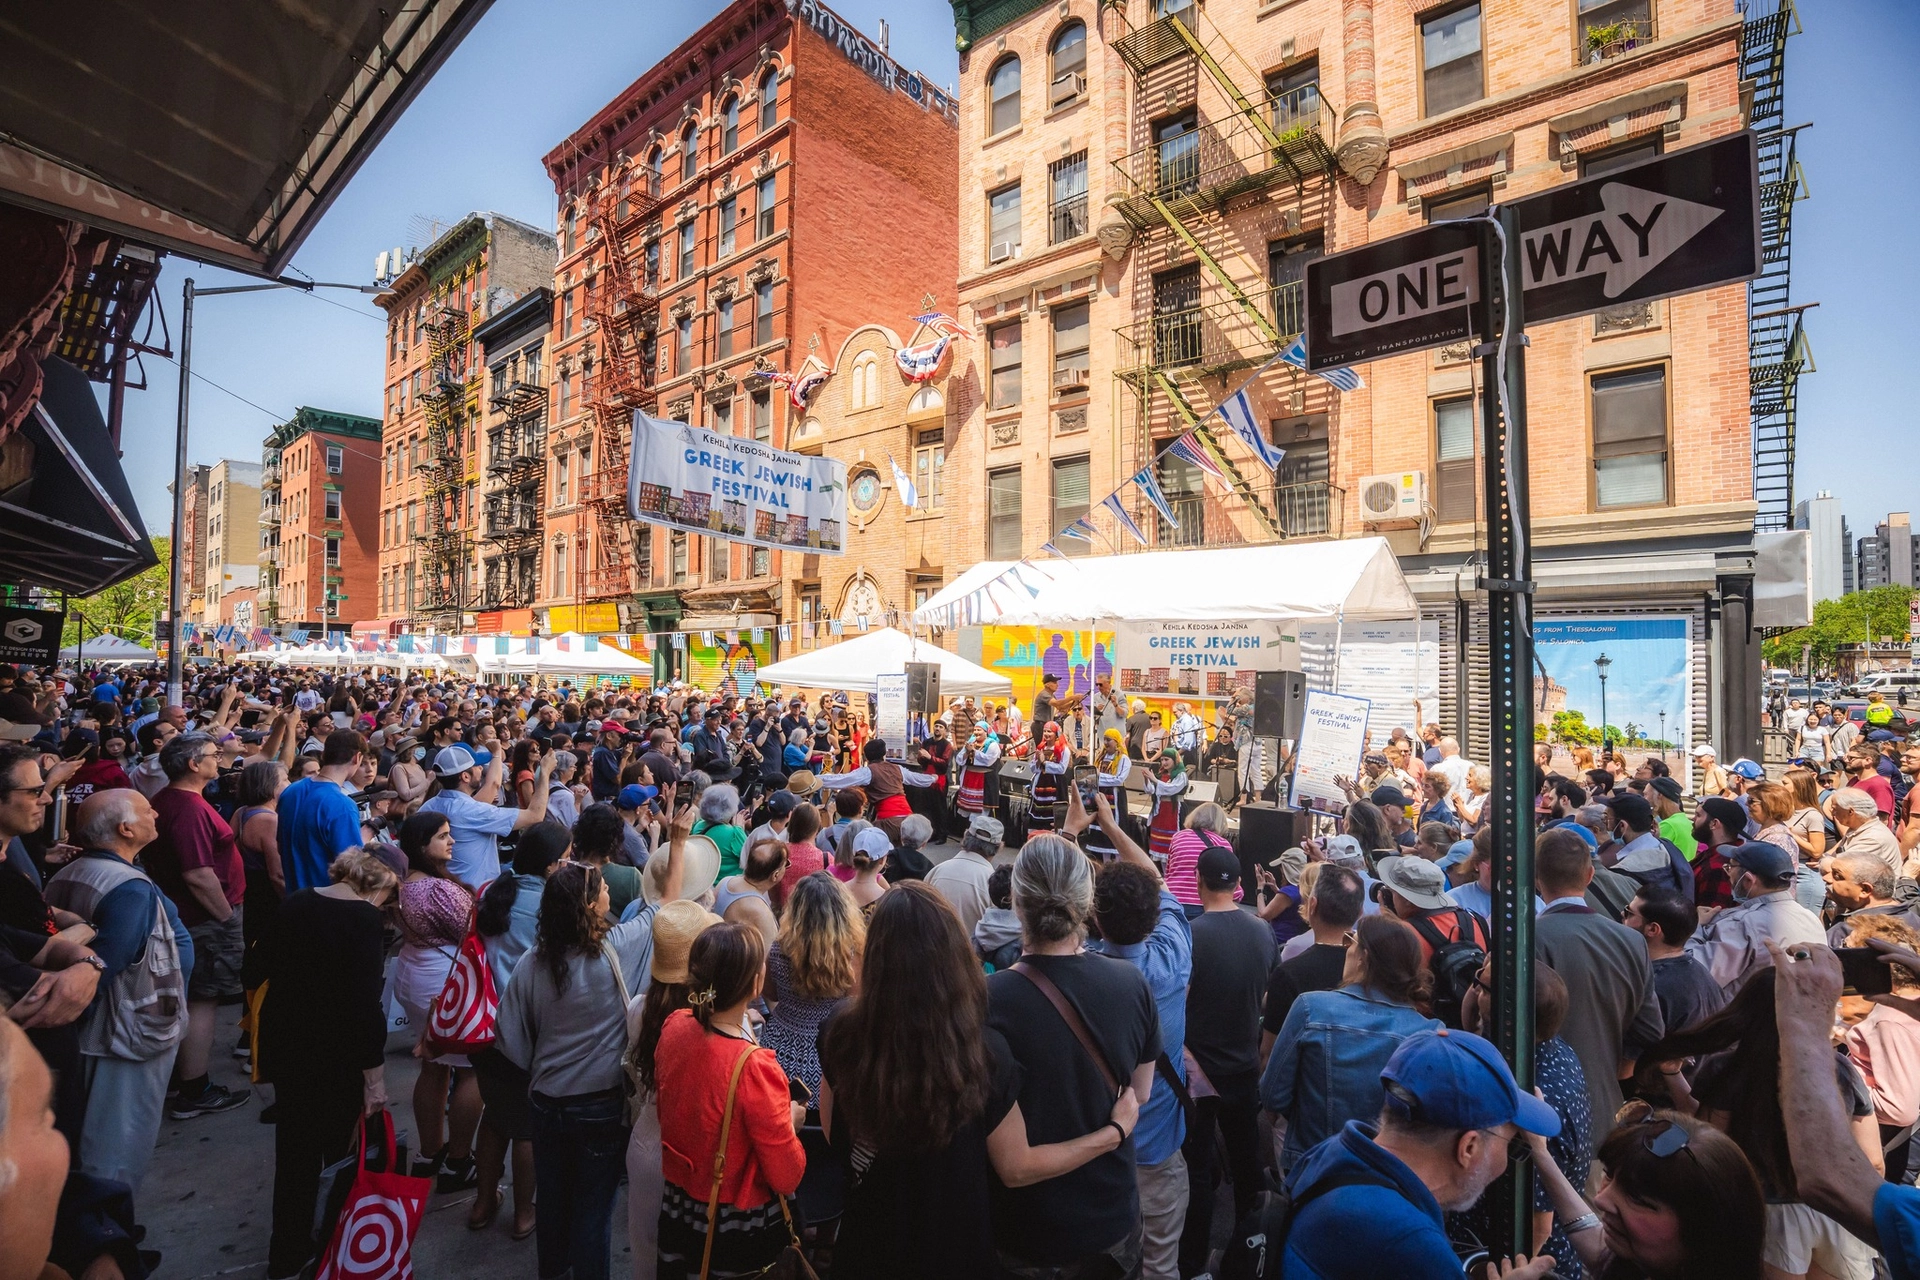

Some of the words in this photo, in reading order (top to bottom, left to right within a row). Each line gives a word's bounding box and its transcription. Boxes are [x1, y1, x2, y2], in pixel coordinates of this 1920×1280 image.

[1359, 256, 1468, 323] ONE
[1525, 201, 1668, 283] WAY
[1323, 354, 1345, 363] DEPT
[1355, 349, 1366, 357] OF
[1377, 327, 1464, 352] TRANSPORTATION
[684, 449, 745, 477] GREEK
[754, 465, 812, 492] JEWISH
[712, 476, 790, 508] FESTIVAL
[1149, 636, 1197, 649] GREEK
[1203, 636, 1261, 649] JEWISH
[1170, 654, 1238, 666] FESTIVAL
[1310, 708, 1334, 718] GREEK
[1335, 713, 1362, 723] JEWISH
[1317, 718, 1352, 730] FESTIVAL
